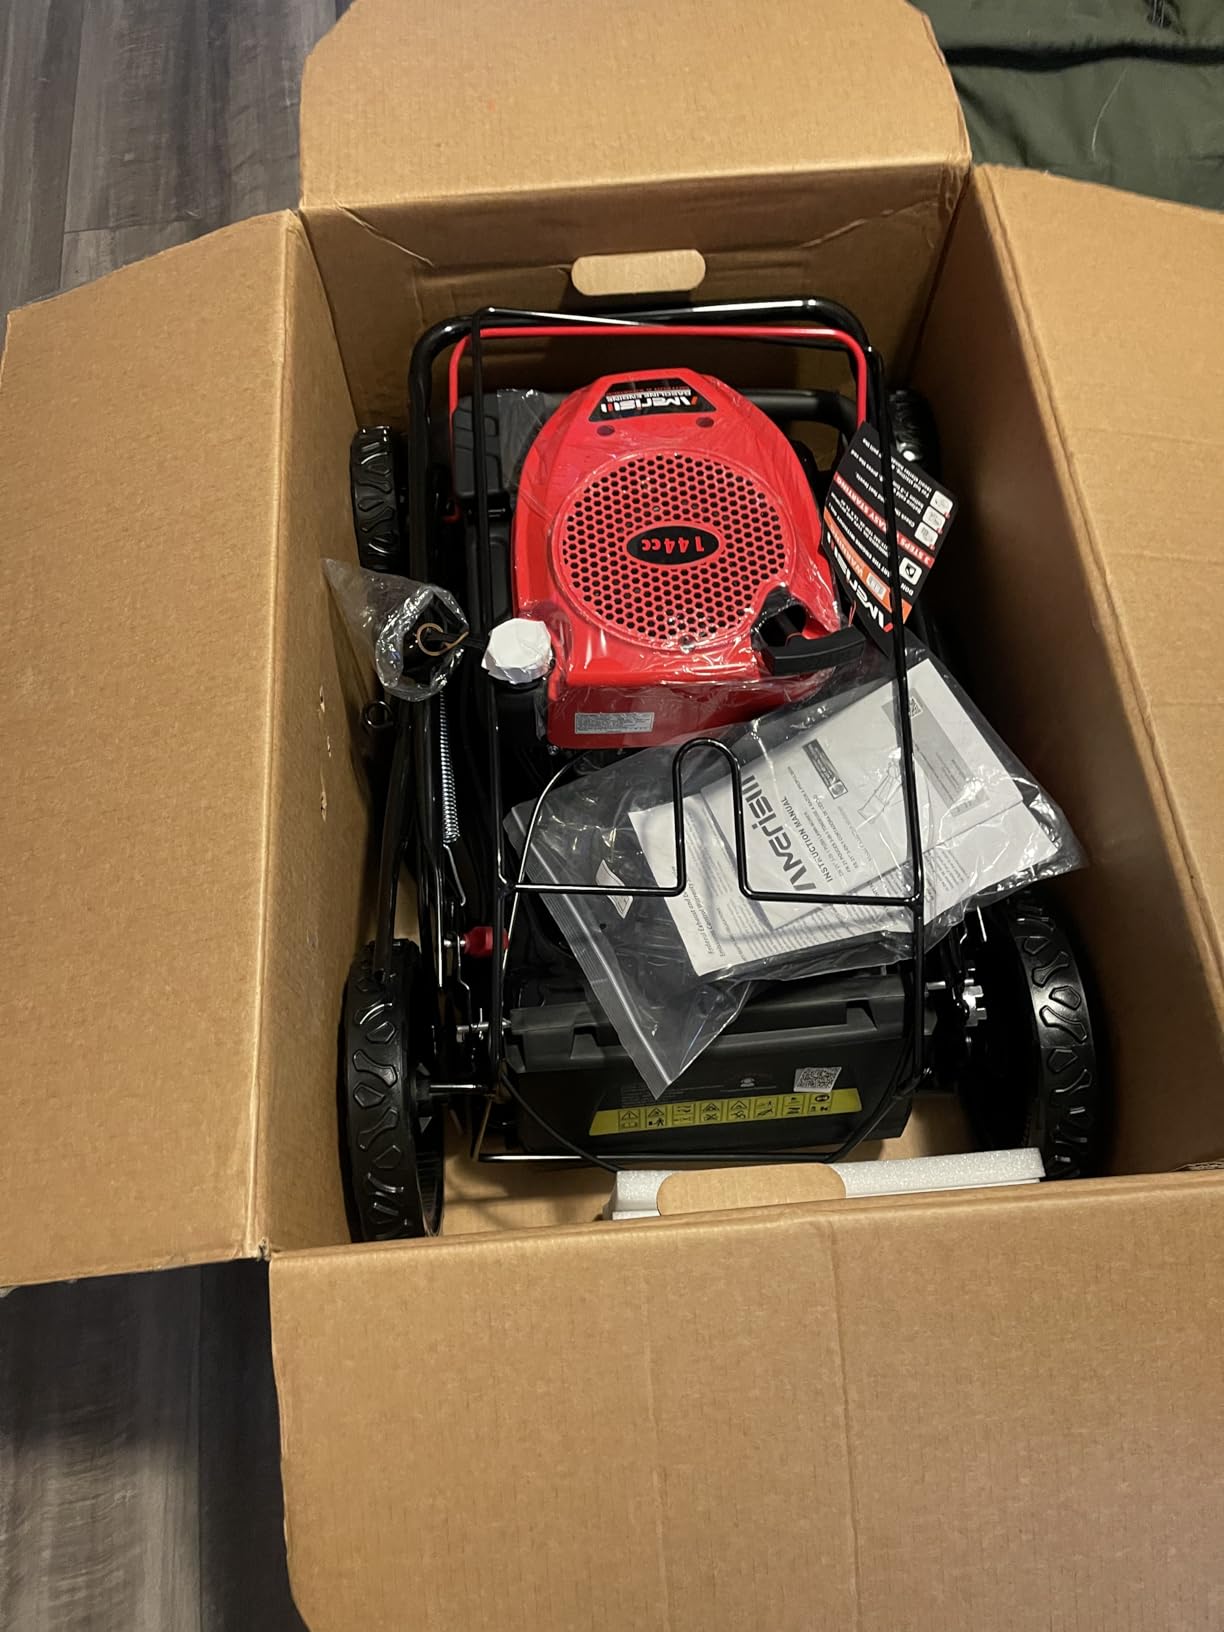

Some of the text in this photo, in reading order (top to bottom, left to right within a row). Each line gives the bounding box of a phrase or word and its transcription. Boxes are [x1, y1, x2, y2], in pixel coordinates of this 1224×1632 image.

[641, 536, 705, 554] 144cc
[899, 581, 914, 596] DON
[780, 795, 833, 882] INSTRUCTION MANUAL
